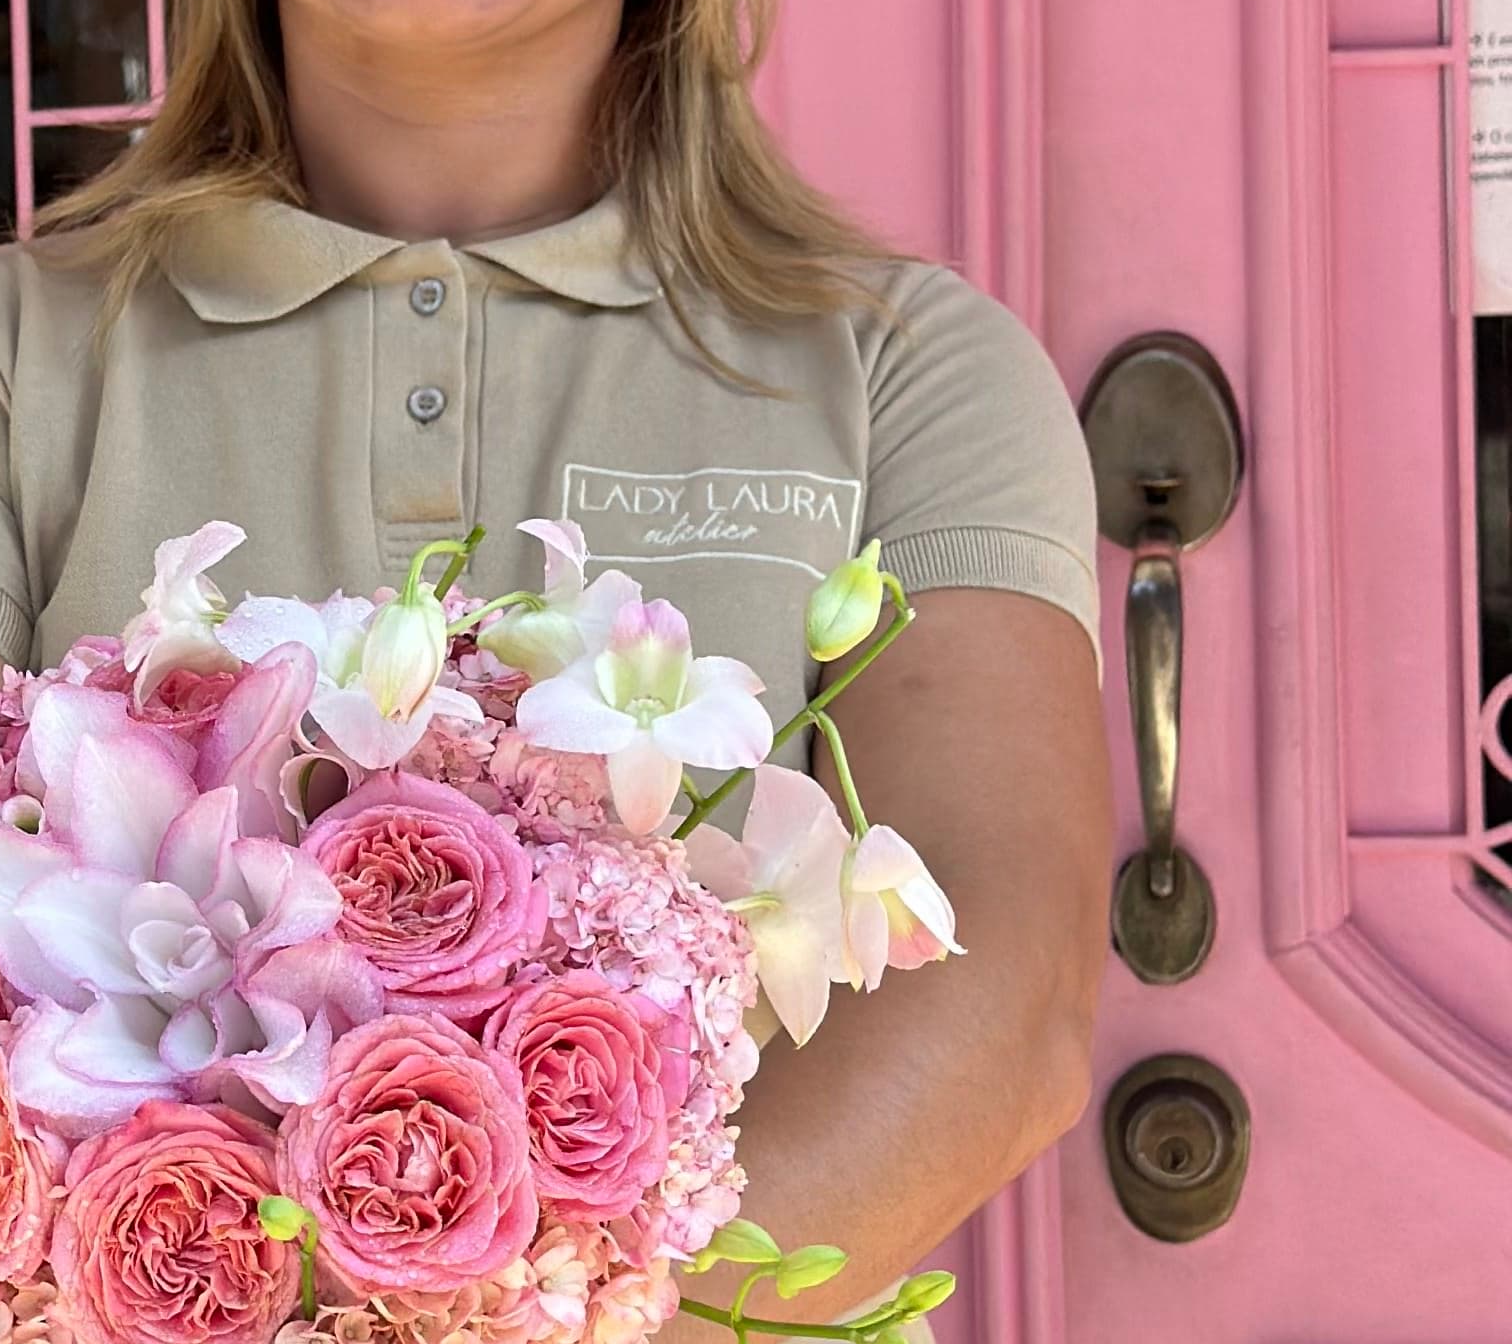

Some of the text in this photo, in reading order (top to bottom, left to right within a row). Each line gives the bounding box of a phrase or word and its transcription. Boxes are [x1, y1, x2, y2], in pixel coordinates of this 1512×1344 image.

[579, 479, 842, 529] LADY LAURA
[643, 512, 759, 546] atelier
